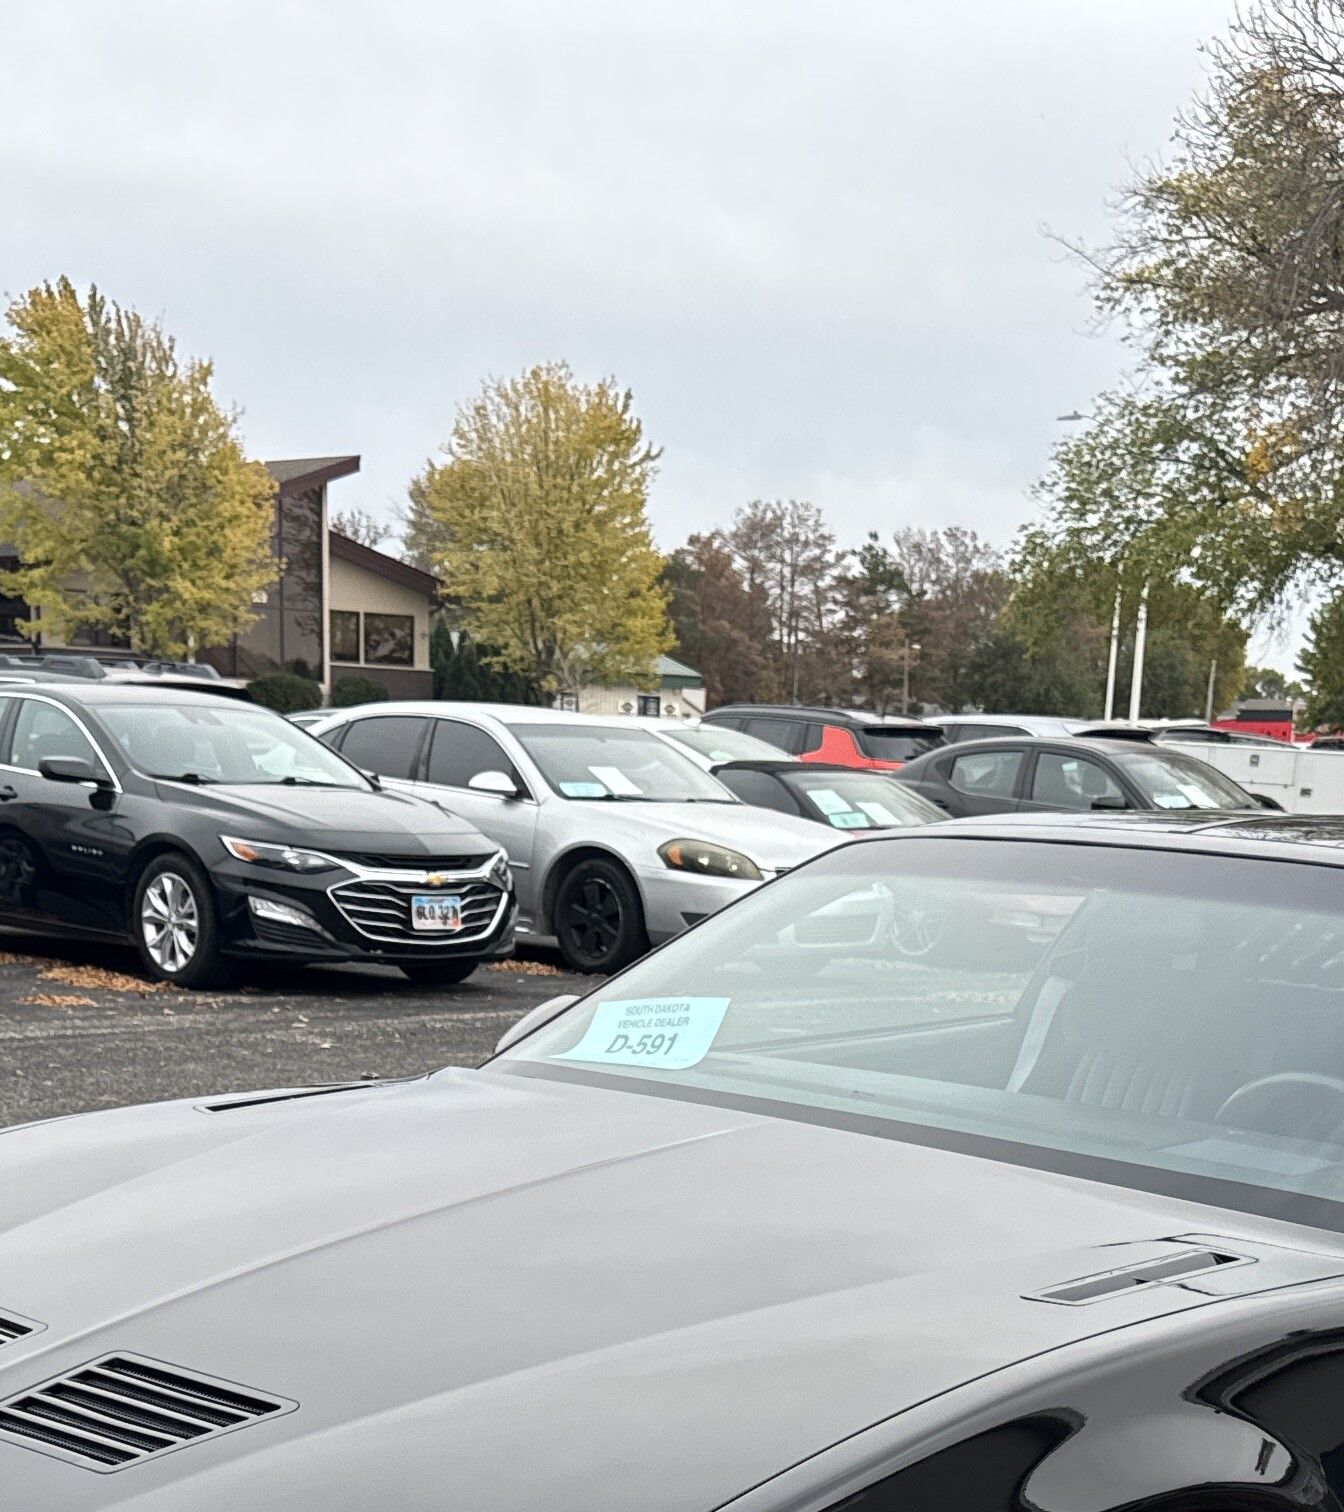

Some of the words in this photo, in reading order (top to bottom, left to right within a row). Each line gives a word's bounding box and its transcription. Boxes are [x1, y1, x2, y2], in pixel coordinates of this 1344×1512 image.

[625, 1005, 655, 1017] SOUTH
[656, 1003, 691, 1014] DAKOTA
[617, 1018, 653, 1030] VEHICLE
[655, 1016, 690, 1028] DEALER
[604, 1032, 679, 1056] D-591
